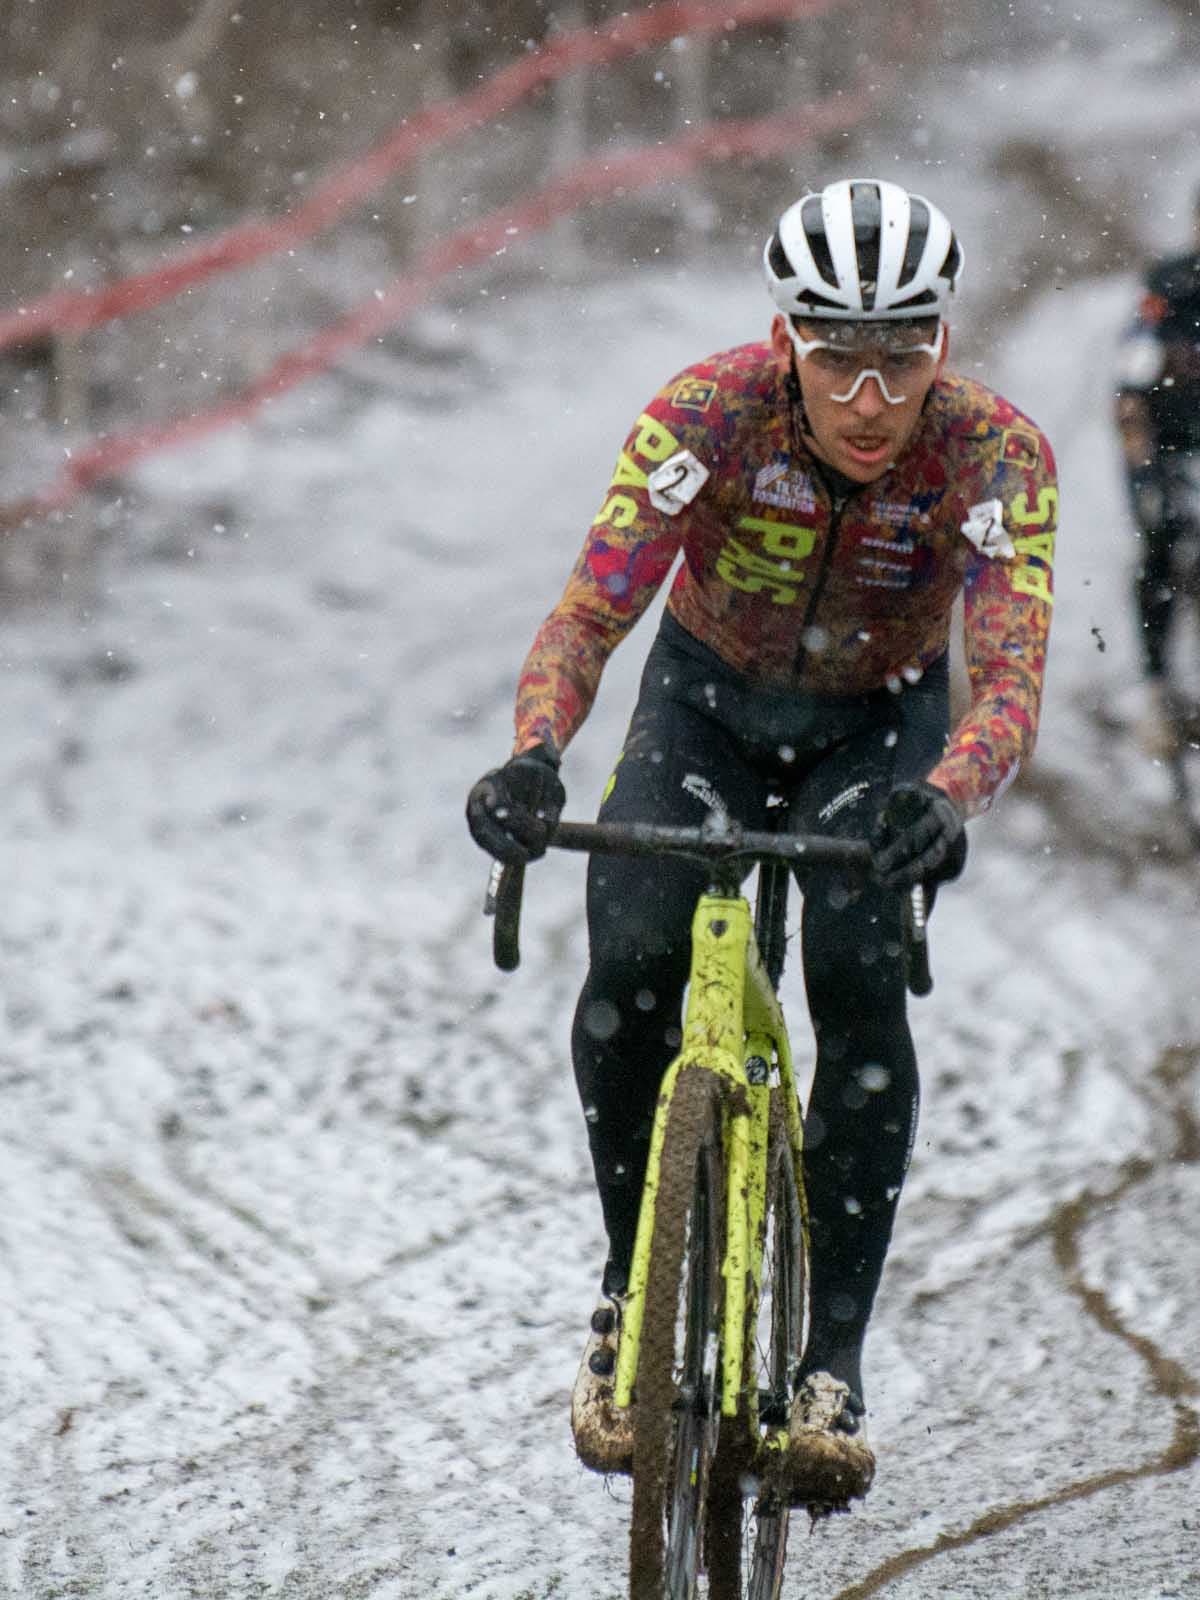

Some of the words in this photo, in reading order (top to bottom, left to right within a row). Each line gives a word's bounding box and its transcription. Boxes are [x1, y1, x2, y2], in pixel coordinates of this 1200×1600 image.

[593, 414, 679, 529] PAS
[656, 465, 688, 500] 2
[716, 516, 817, 604] PAS
[1011, 487, 1058, 603] PAS
